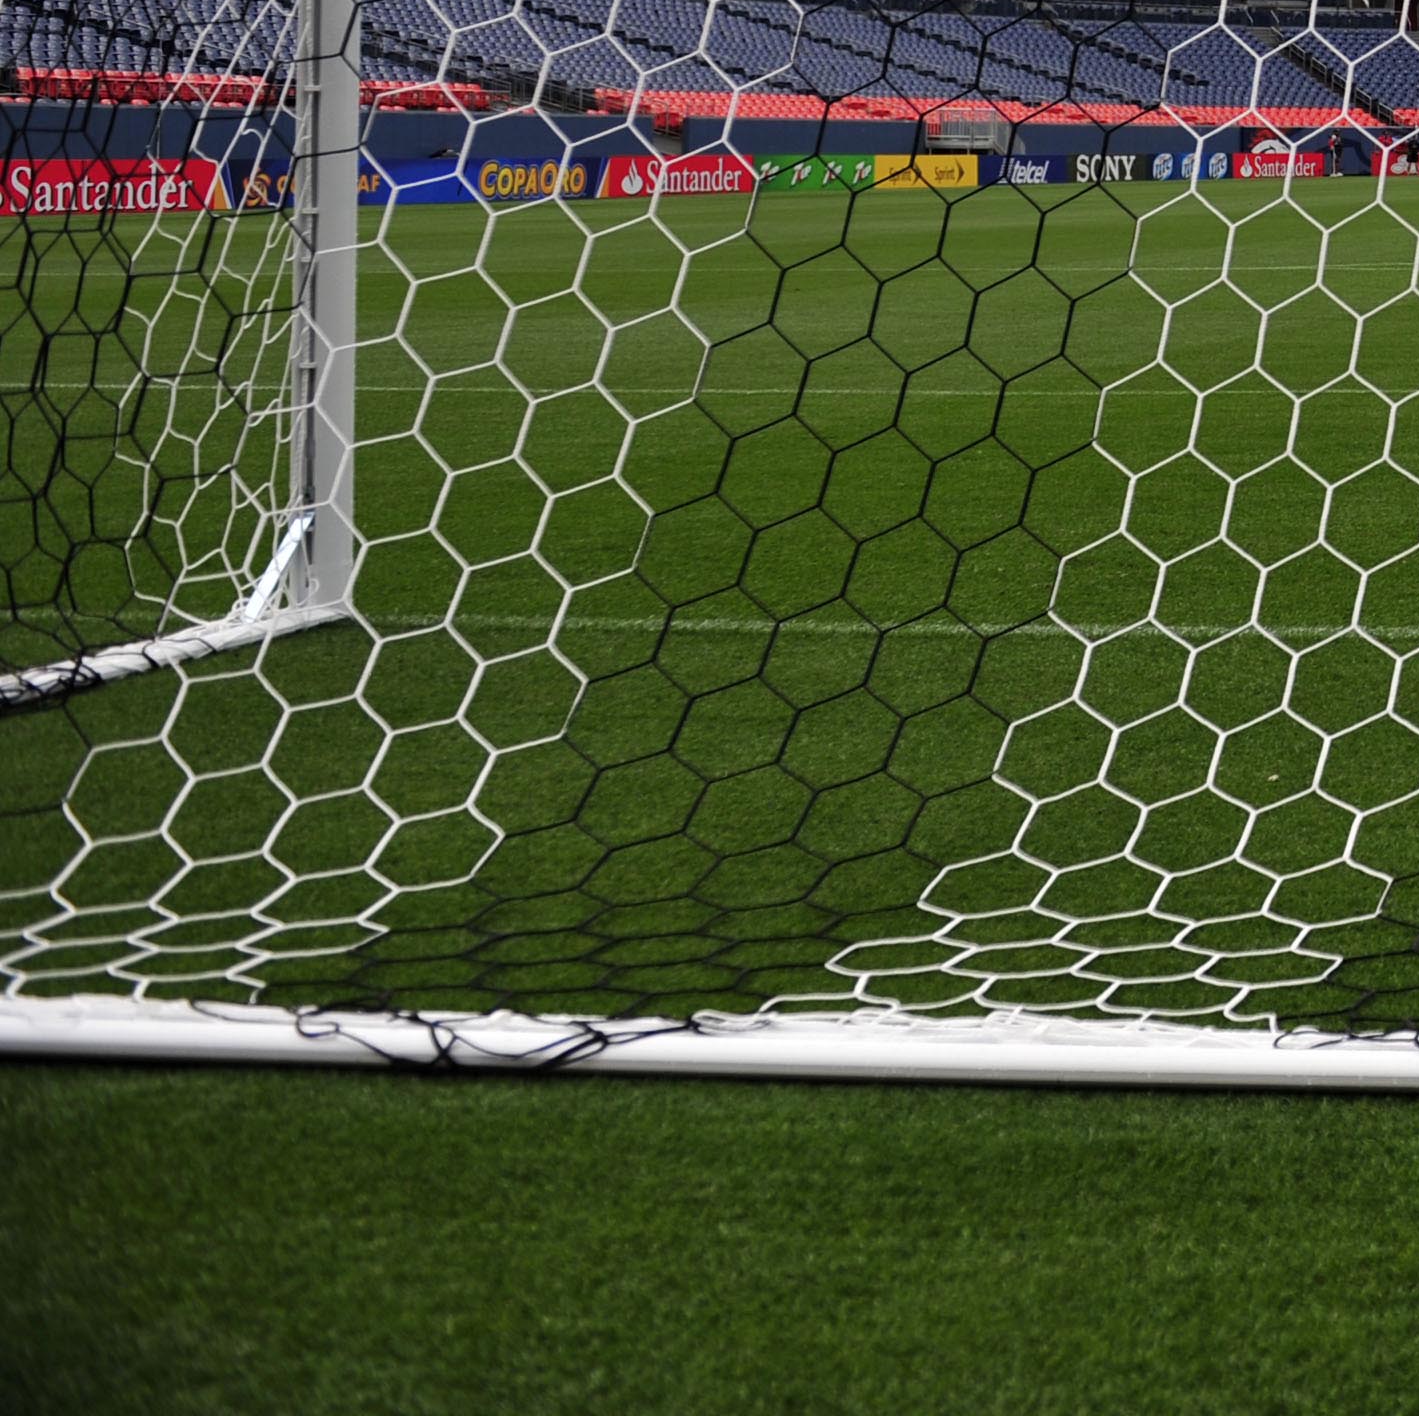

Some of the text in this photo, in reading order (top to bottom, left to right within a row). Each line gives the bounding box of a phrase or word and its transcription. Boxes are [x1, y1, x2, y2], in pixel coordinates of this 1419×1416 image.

[646, 159, 742, 193] Santander
[1011, 159, 1050, 184] telcel
[1076, 154, 1136, 182] SONY
[1254, 155, 1316, 178] Santader
[10, 163, 192, 212] Santander
